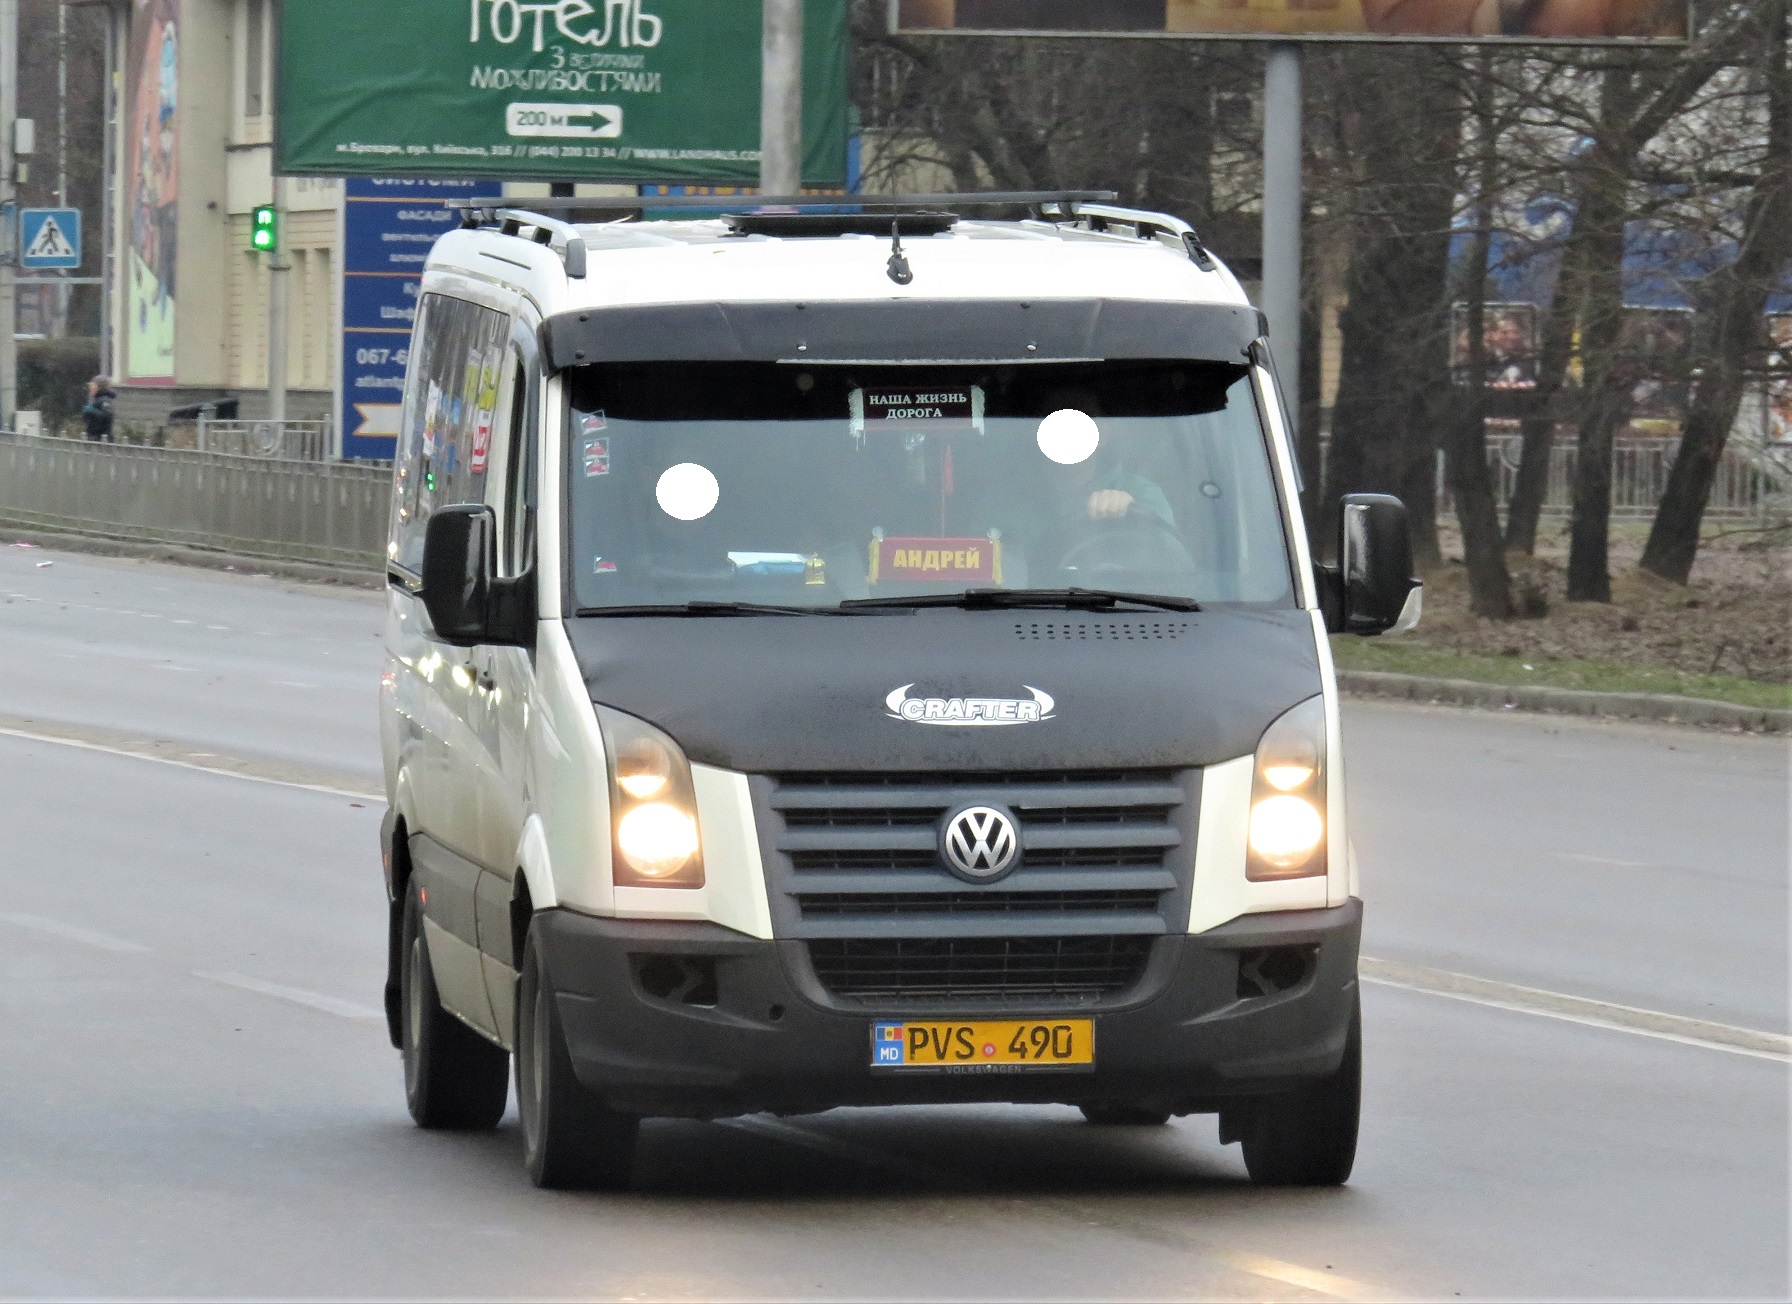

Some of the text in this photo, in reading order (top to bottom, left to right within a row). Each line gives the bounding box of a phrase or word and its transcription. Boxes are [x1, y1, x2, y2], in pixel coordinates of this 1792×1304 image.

[470, 65, 661, 93] МОЖЛИВОСТЯМИ
[516, 111, 548, 126] 200
[869, 393, 967, 405] НАША ЖИЗНЬ
[886, 408, 942, 420] ДОРОГА
[893, 547, 980, 571] АНДРЕЙ
[901, 699, 1041, 721] CRAFTER
[908, 1025, 1073, 1060] PVS 490
[880, 1047, 899, 1061] MD
[946, 1066, 1022, 1074] VOLKSWAGEN
